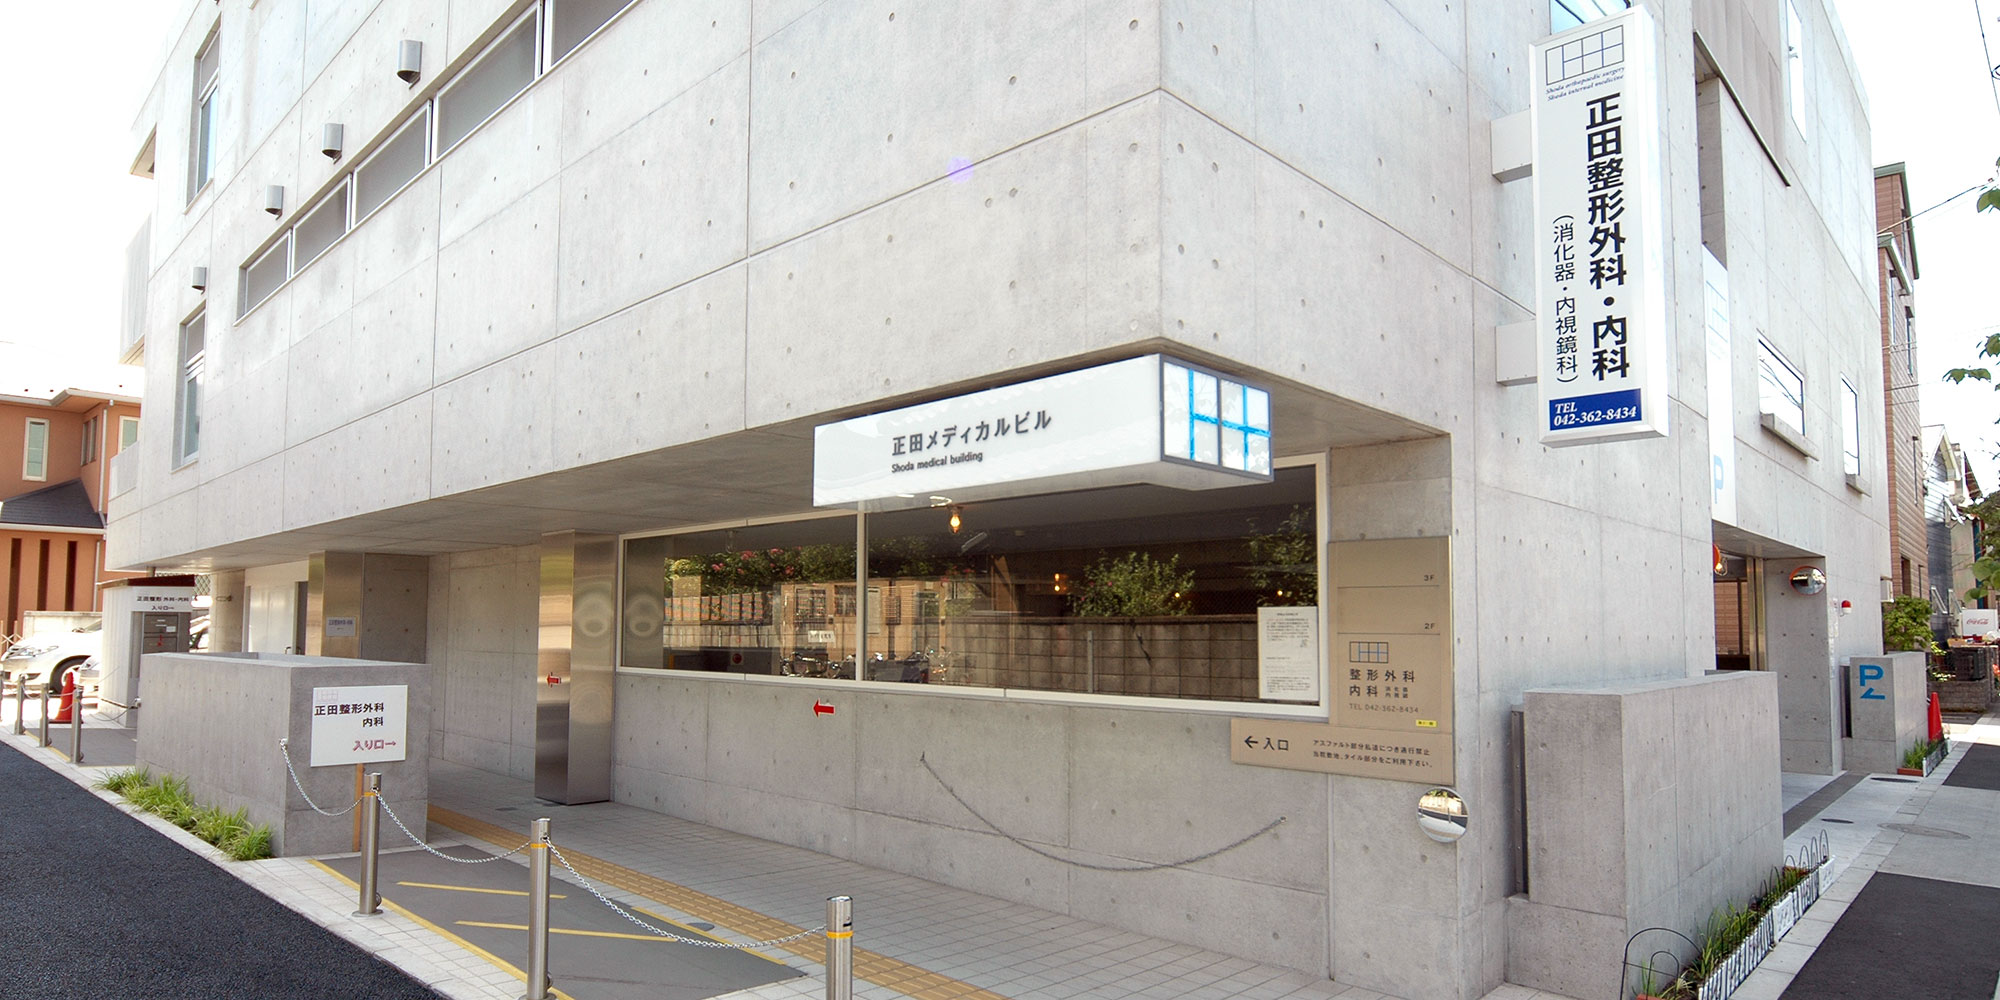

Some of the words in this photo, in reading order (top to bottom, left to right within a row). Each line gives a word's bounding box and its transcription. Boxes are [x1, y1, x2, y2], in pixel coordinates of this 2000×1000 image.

[1585, 92, 1630, 381] 正田整形外科・内科
[1555, 402, 1577, 414] TEL
[1554, 406, 1637, 427] 042-362-8434
[892, 410, 1052, 456] 正田メディカルビル
[891, 461, 915, 473] Shoda
[917, 455, 947, 469] medical
[950, 451, 983, 464] building
[1859, 664, 1885, 687] P
[1350, 684, 1378, 697] 内科
[314, 702, 384, 716] 正田整形外科
[1349, 703, 1362, 711] TEL
[362, 716, 384, 727] 内科
[353, 739, 384, 751] 入り口
[1263, 737, 1289, 751] 入口
